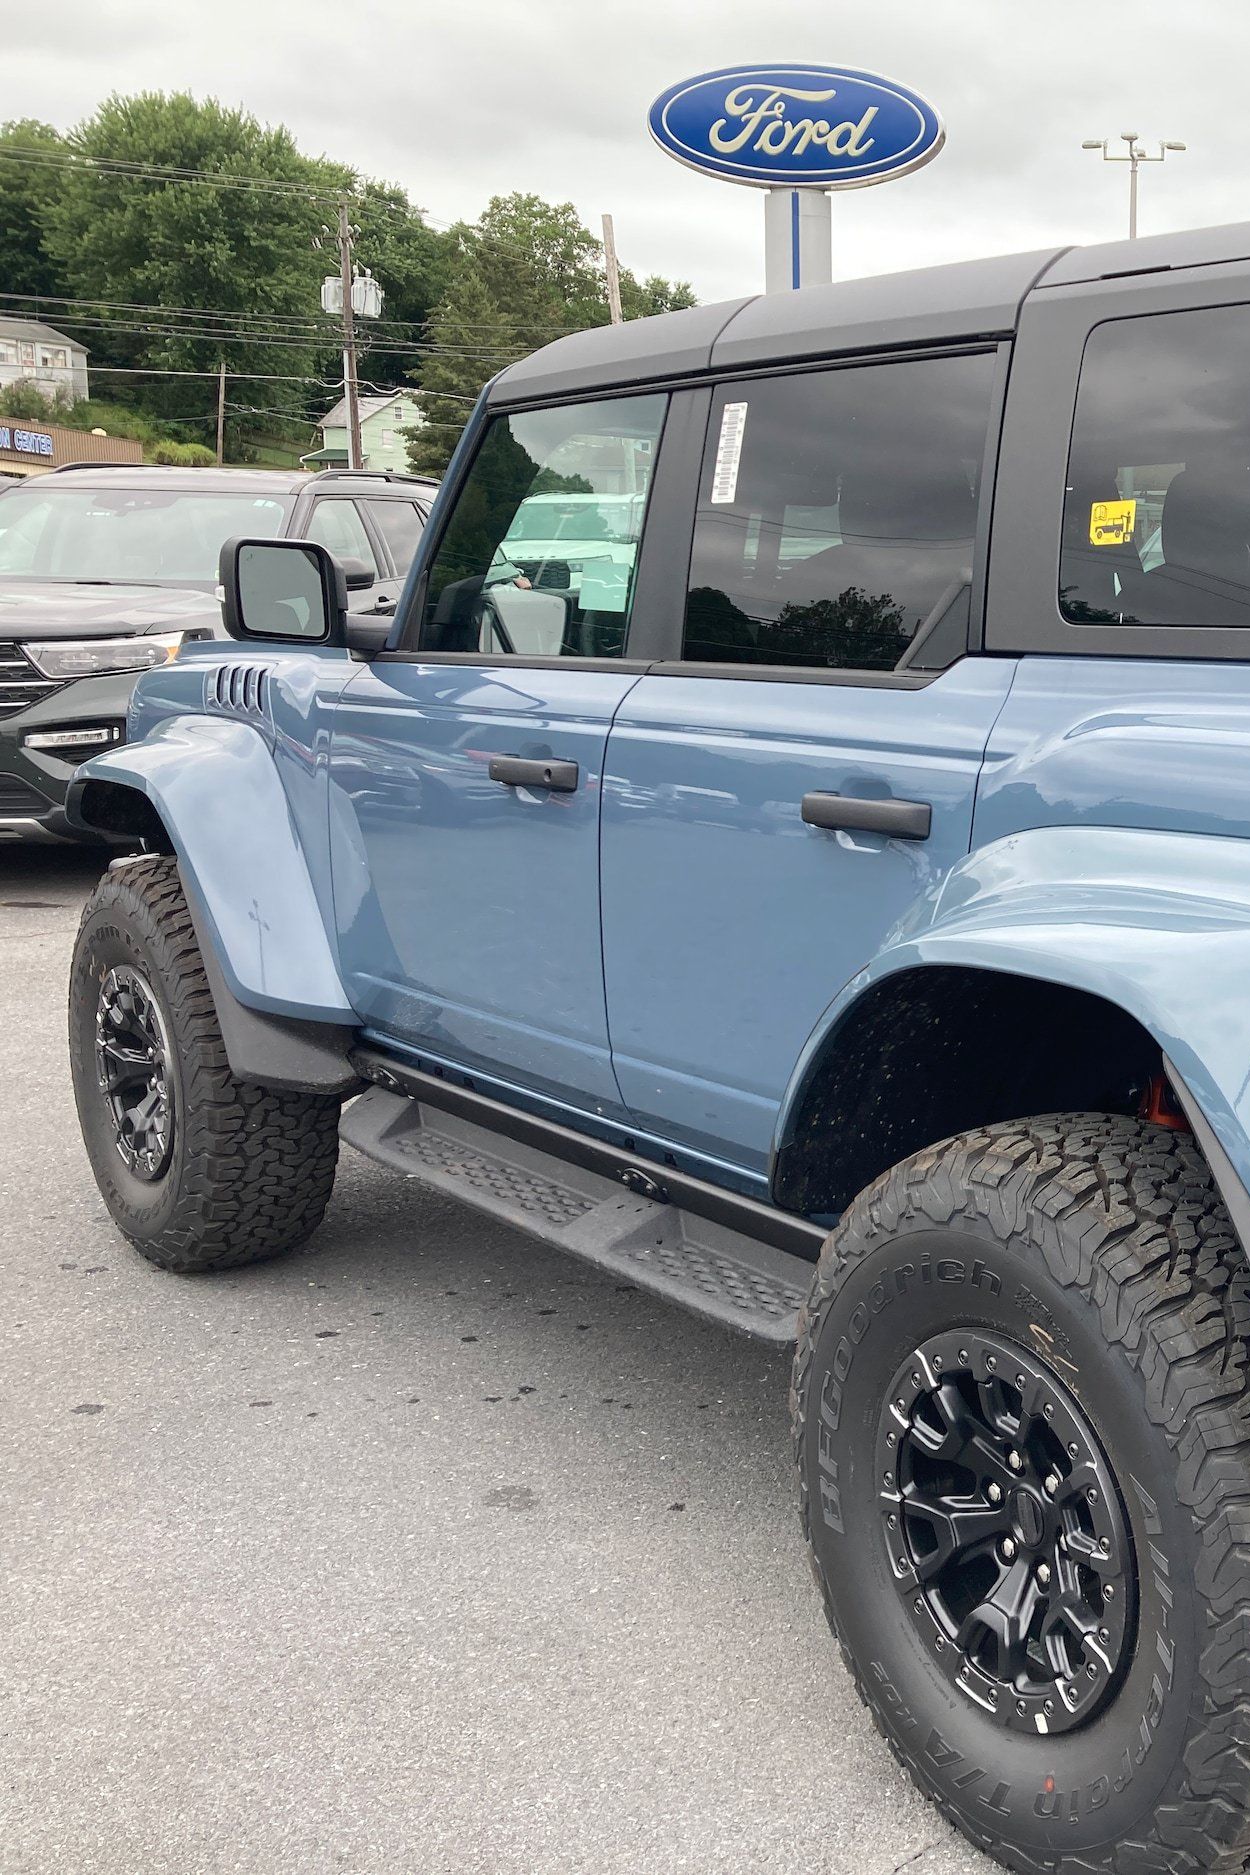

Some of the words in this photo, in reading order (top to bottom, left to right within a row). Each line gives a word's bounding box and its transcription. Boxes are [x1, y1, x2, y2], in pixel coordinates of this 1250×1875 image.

[708, 83, 880, 157] Ford
[14, 428, 54, 456] CENTER
[818, 1252, 1003, 1535] BFGoodrich
